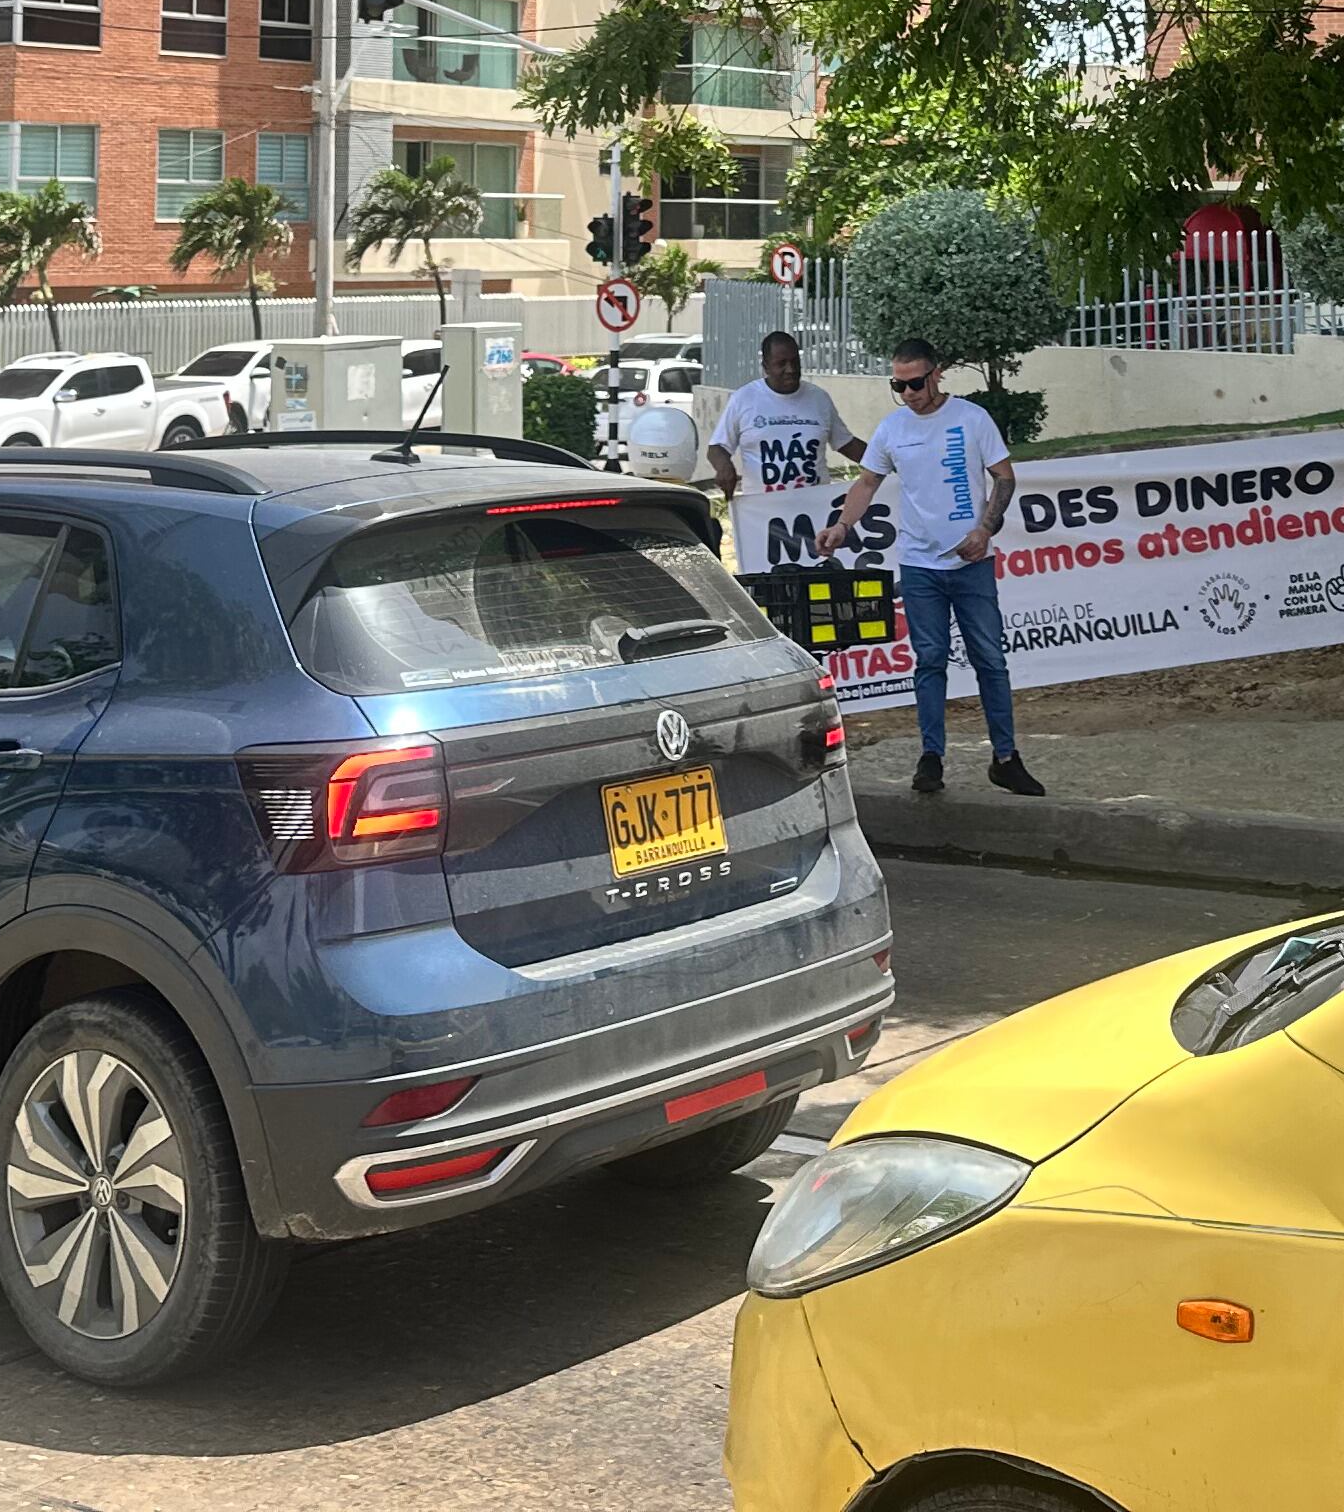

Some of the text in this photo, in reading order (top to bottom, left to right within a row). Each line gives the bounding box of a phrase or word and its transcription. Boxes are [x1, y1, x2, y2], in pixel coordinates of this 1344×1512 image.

[760, 431, 821, 464] MÁS
[1018, 485, 1119, 534] DES
[1134, 460, 1335, 518] DINERO
[993, 537, 1125, 580] tamos
[1289, 571, 1321, 584] DE LA
[1004, 602, 1096, 629] LCALDÍA DE
[1284, 593, 1325, 607] CON LA
[1000, 608, 1180, 654] BARRANQUILLA
[829, 643, 914, 681] ITAS
[636, 836, 707, 866] BARRANQUILLA
[606, 861, 732, 905] T-CROSS
